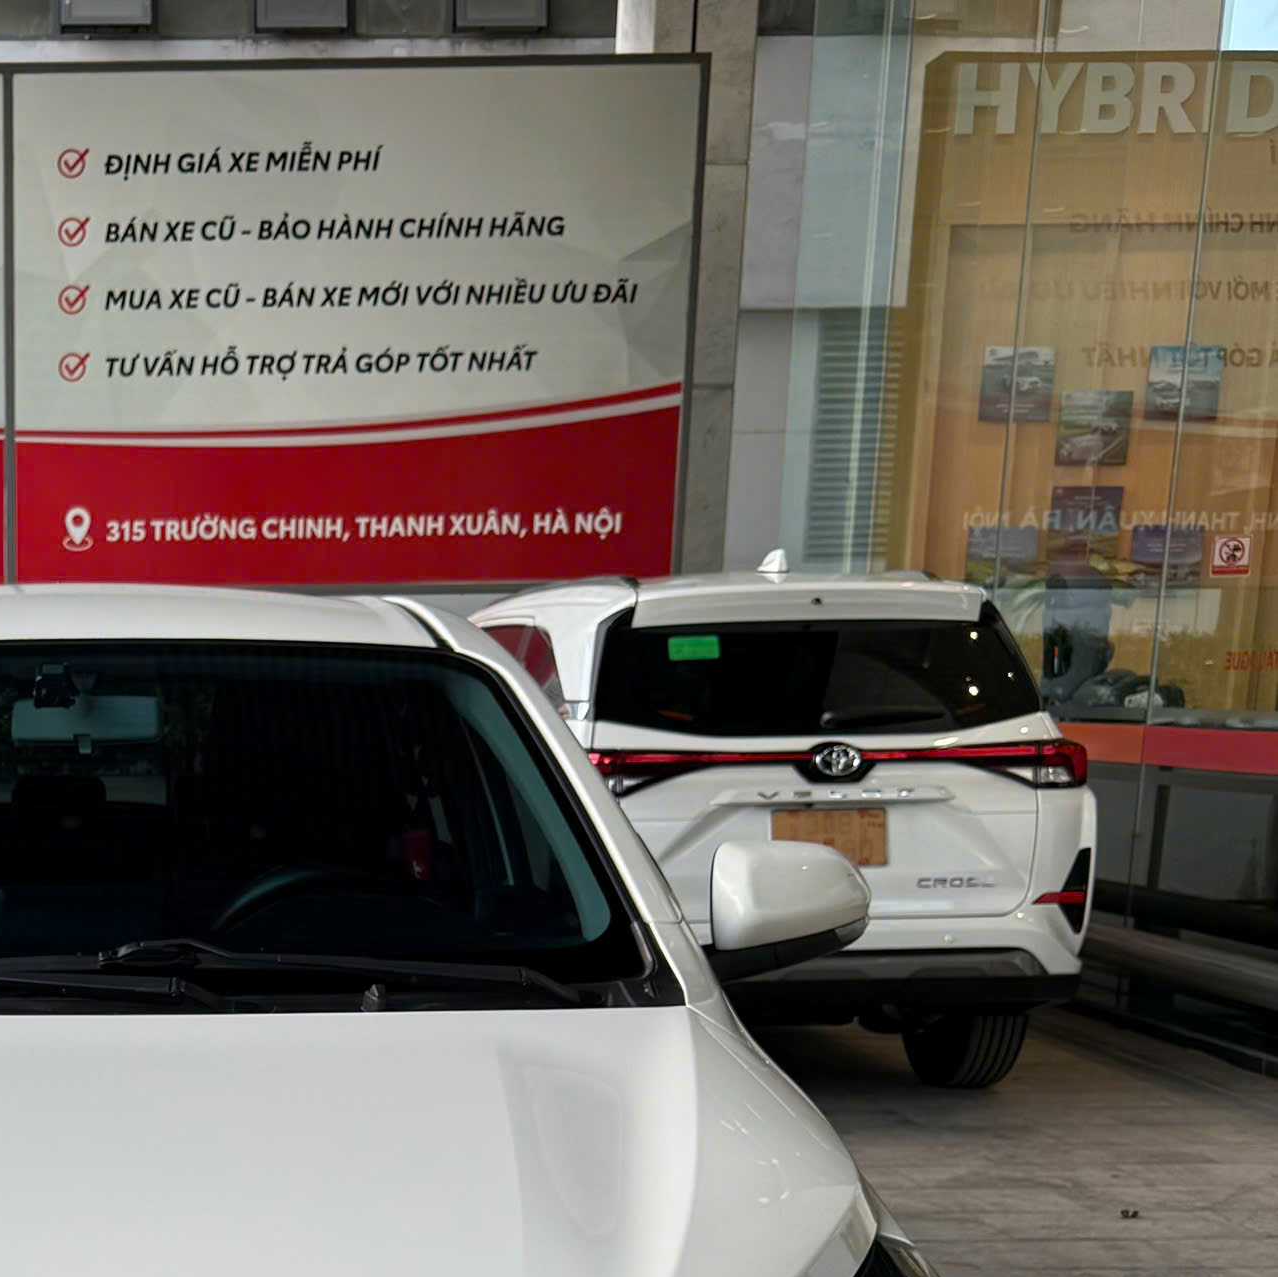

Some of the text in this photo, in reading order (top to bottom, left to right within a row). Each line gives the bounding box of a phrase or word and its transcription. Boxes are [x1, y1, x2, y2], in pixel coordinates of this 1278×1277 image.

[953, 60, 1278, 136] HYBRID
[105, 141, 383, 181] ĐỊNH GIÁ XE MIỄN PHÍ
[105, 216, 158, 243] BÁN
[163, 221, 195, 242] XE
[201, 215, 236, 241] CŨ
[258, 212, 311, 240] BẢO
[317, 213, 393, 240] HÀNH
[399, 212, 483, 239] CHÍNH
[489, 211, 566, 238] HÃNG
[105, 289, 162, 310] MUA
[168, 288, 200, 309] XE
[206, 283, 240, 308] CŨ
[262, 282, 315, 308] BÁN
[321, 286, 353, 307] XE
[357, 280, 409, 306] MỚI
[416, 279, 460, 305] VỚI
[466, 277, 546, 304] NHIỀU
[552, 280, 587, 304] ƯU
[593, 278, 638, 304] ĐÃI
[106, 344, 538, 380] TƯ VẤN HỖ TRỢ TRẢ GÓP TỐT NHẤT
[106, 506, 622, 542] 315 TRƯỜNG CHINH, THANH XUÂN, HÀ NỘI
